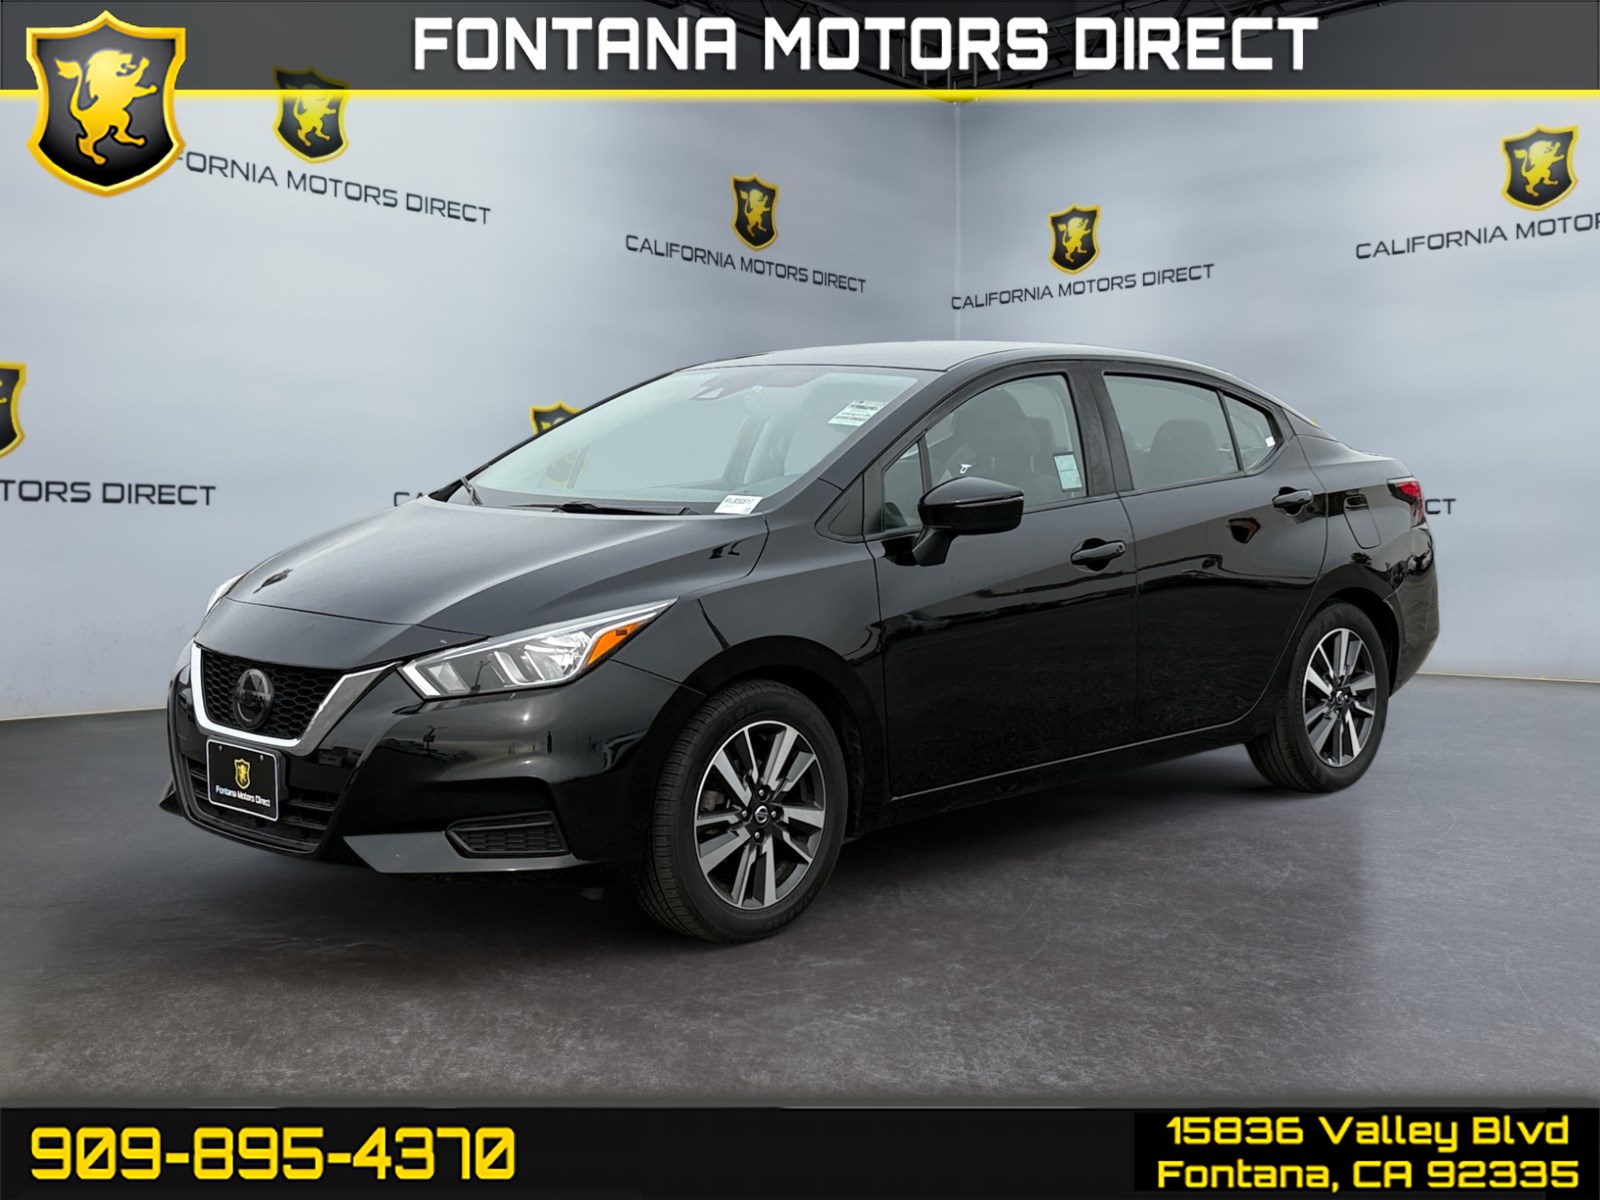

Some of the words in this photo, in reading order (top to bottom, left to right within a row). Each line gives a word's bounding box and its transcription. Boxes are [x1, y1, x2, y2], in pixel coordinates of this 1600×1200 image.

[178, 151, 278, 187] ORNIA
[286, 169, 398, 208] MOTORS
[405, 192, 491, 225] DIRECT
[625, 234, 736, 270] CALIFORNIA
[740, 256, 809, 283] MOTORS
[812, 270, 866, 293] DIRECT
[1355, 225, 1508, 260] CALIFORNIA
[951, 285, 1054, 310] CALIFORNIA
[1058, 273, 1137, 298] MOTORS
[1142, 263, 1215, 287] DIRECT
[102, 482, 216, 506] DIRECT
